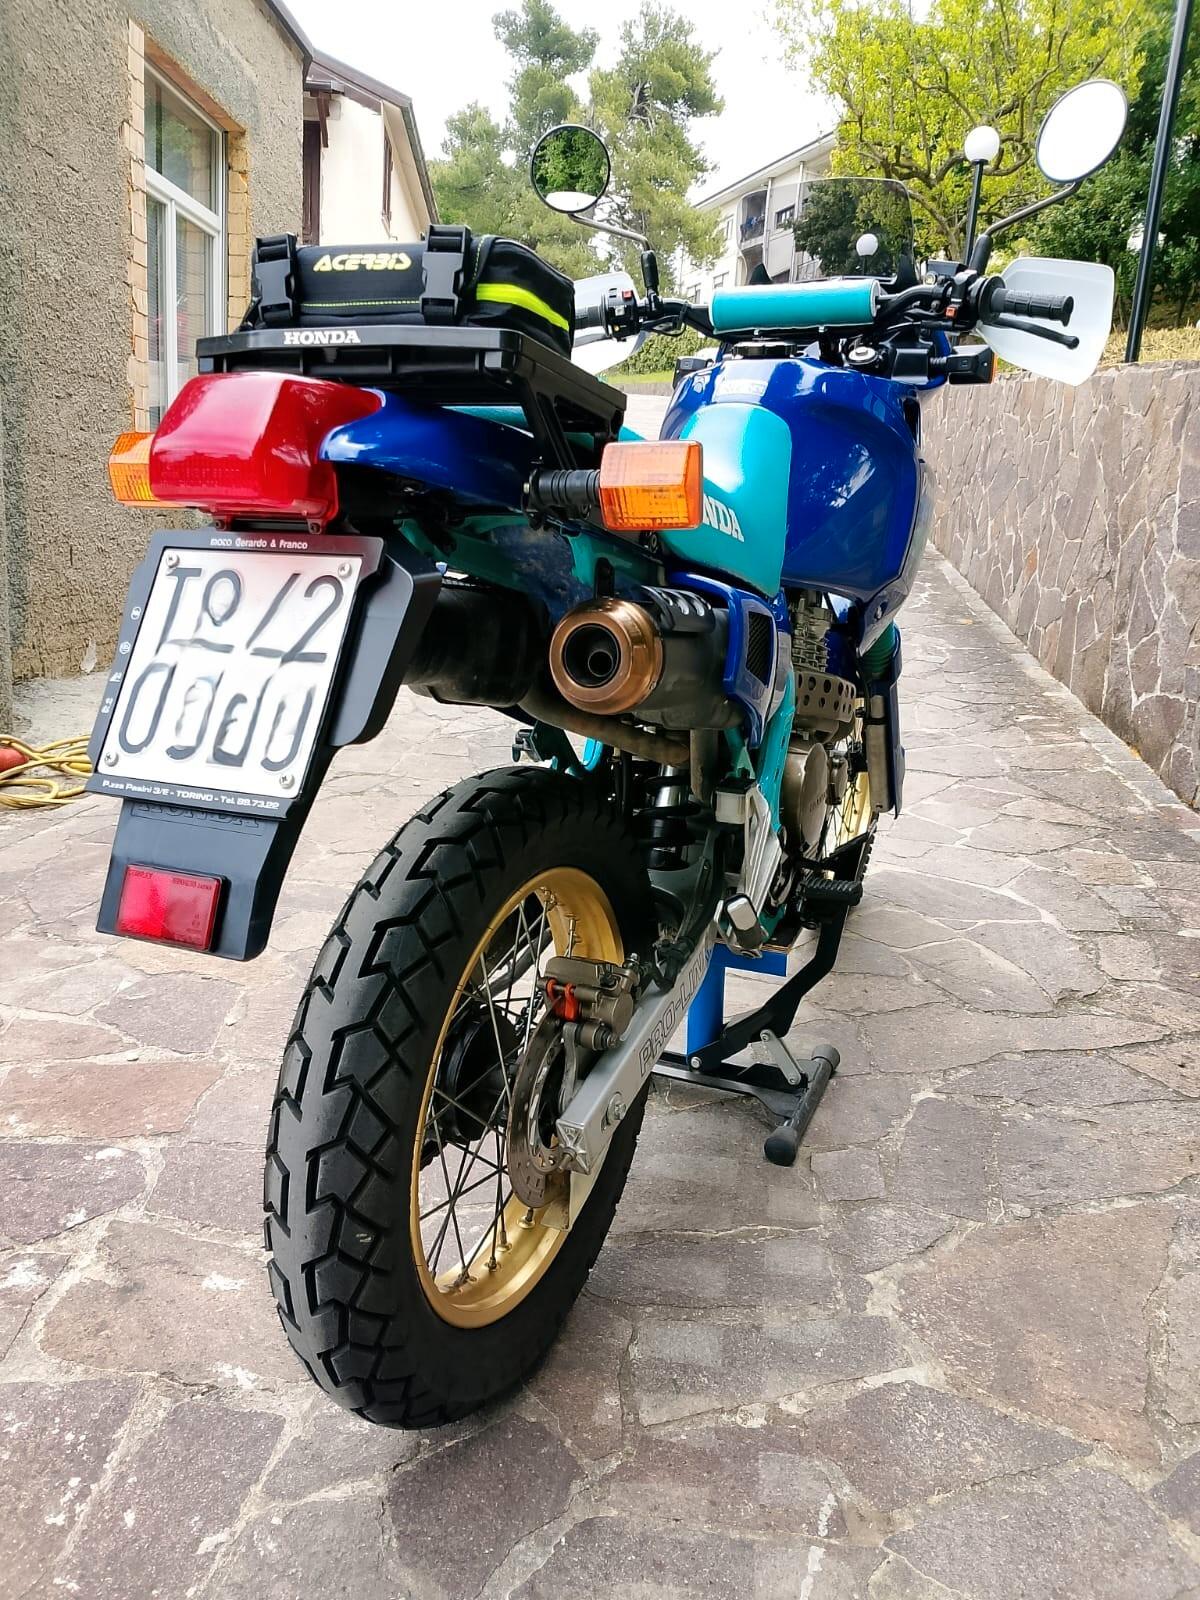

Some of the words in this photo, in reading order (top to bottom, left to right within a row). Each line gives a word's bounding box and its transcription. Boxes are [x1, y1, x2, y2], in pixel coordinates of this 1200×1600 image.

[313, 252, 412, 272] ACERBIS
[283, 330, 361, 345] HONDA
[703, 493, 745, 543] NDA
[235, 537, 267, 548] Gerardo
[279, 539, 308, 550] Franco
[176, 790, 214, 802] TORINO
